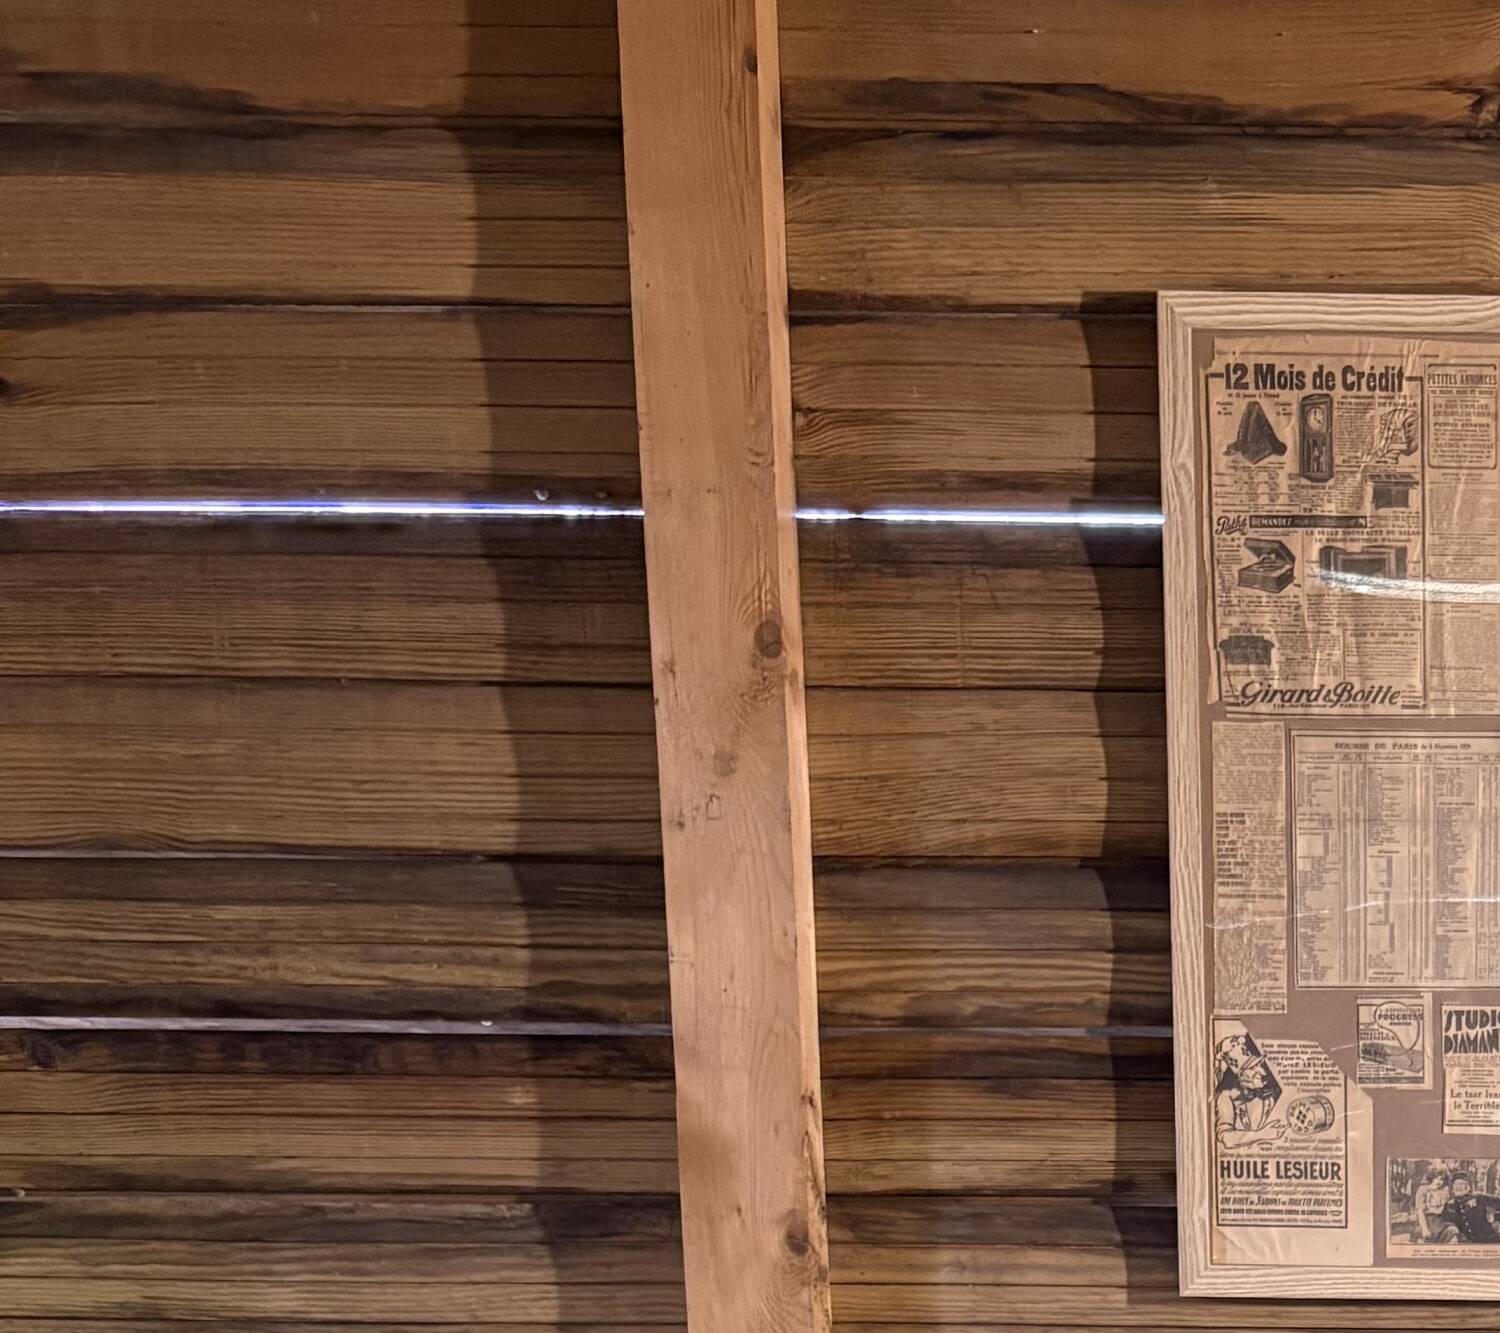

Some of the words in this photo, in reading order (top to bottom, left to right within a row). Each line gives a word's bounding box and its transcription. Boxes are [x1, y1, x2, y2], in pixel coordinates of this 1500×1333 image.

[1224, 363, 1249, 390] 12
[1254, 363, 1306, 391] Mois
[1312, 364, 1336, 391] de
[1341, 364, 1405, 392] Crédit
[1428, 374, 1459, 385] PETITES
[1450, 1088, 1463, 1098] Le
[1220, 1160, 1270, 1179] HUILE
[1276, 1161, 1342, 1180] LESIEUR
